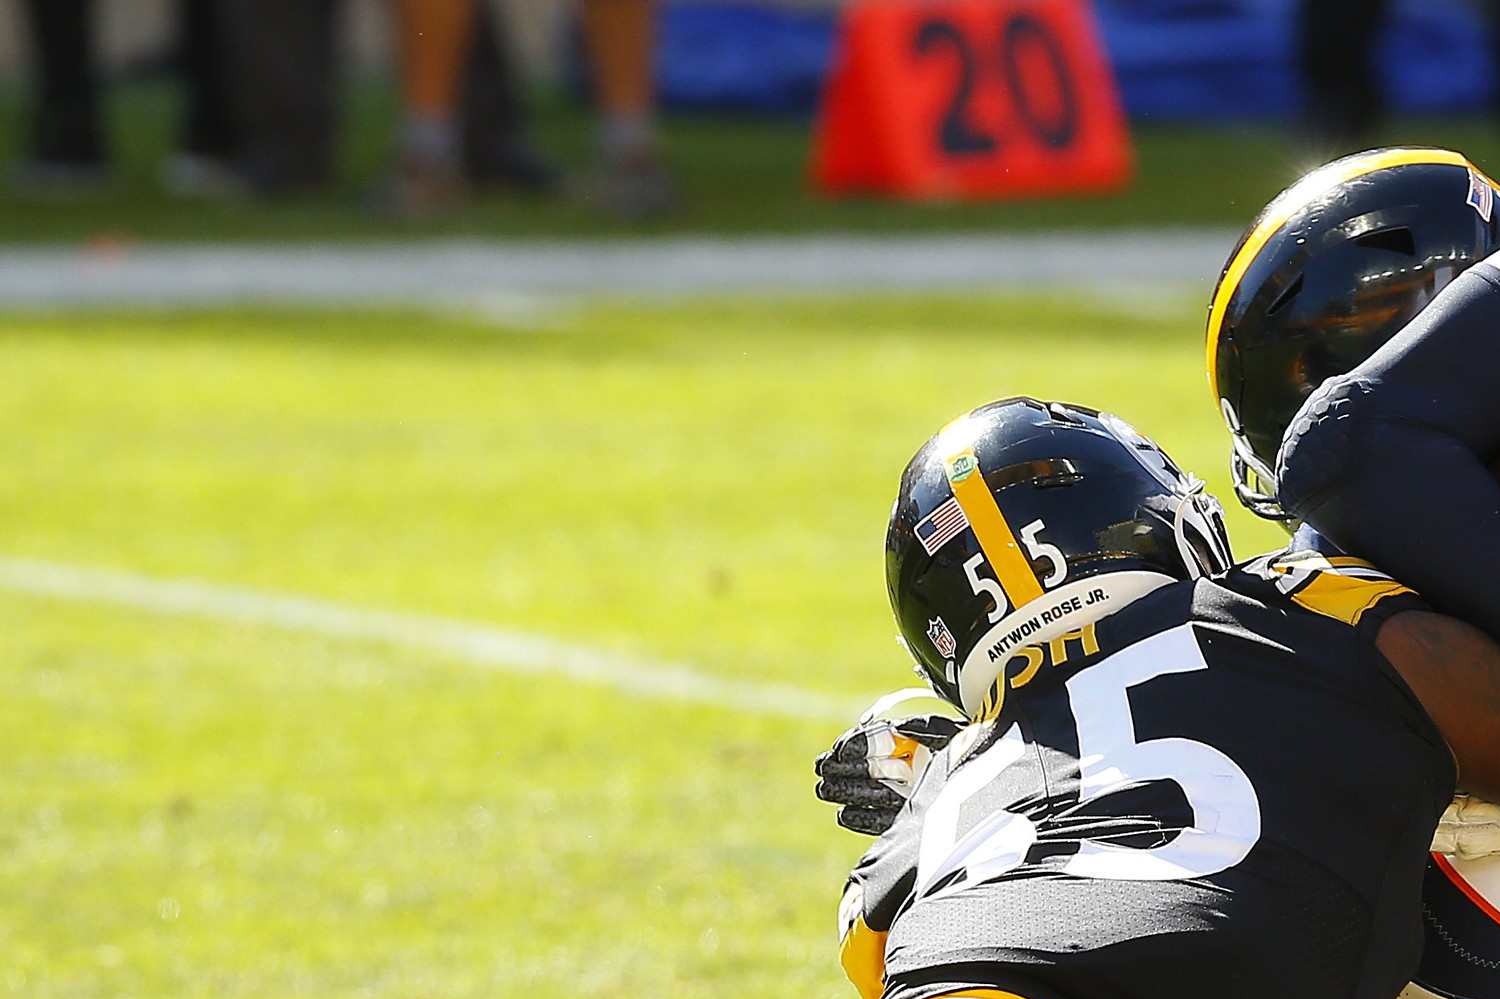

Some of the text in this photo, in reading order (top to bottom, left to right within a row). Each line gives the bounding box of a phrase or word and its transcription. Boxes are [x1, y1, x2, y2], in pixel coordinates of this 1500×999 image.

[915, 17, 1079, 151] 20
[986, 588, 1110, 663] ANTWON ROSE JR.
